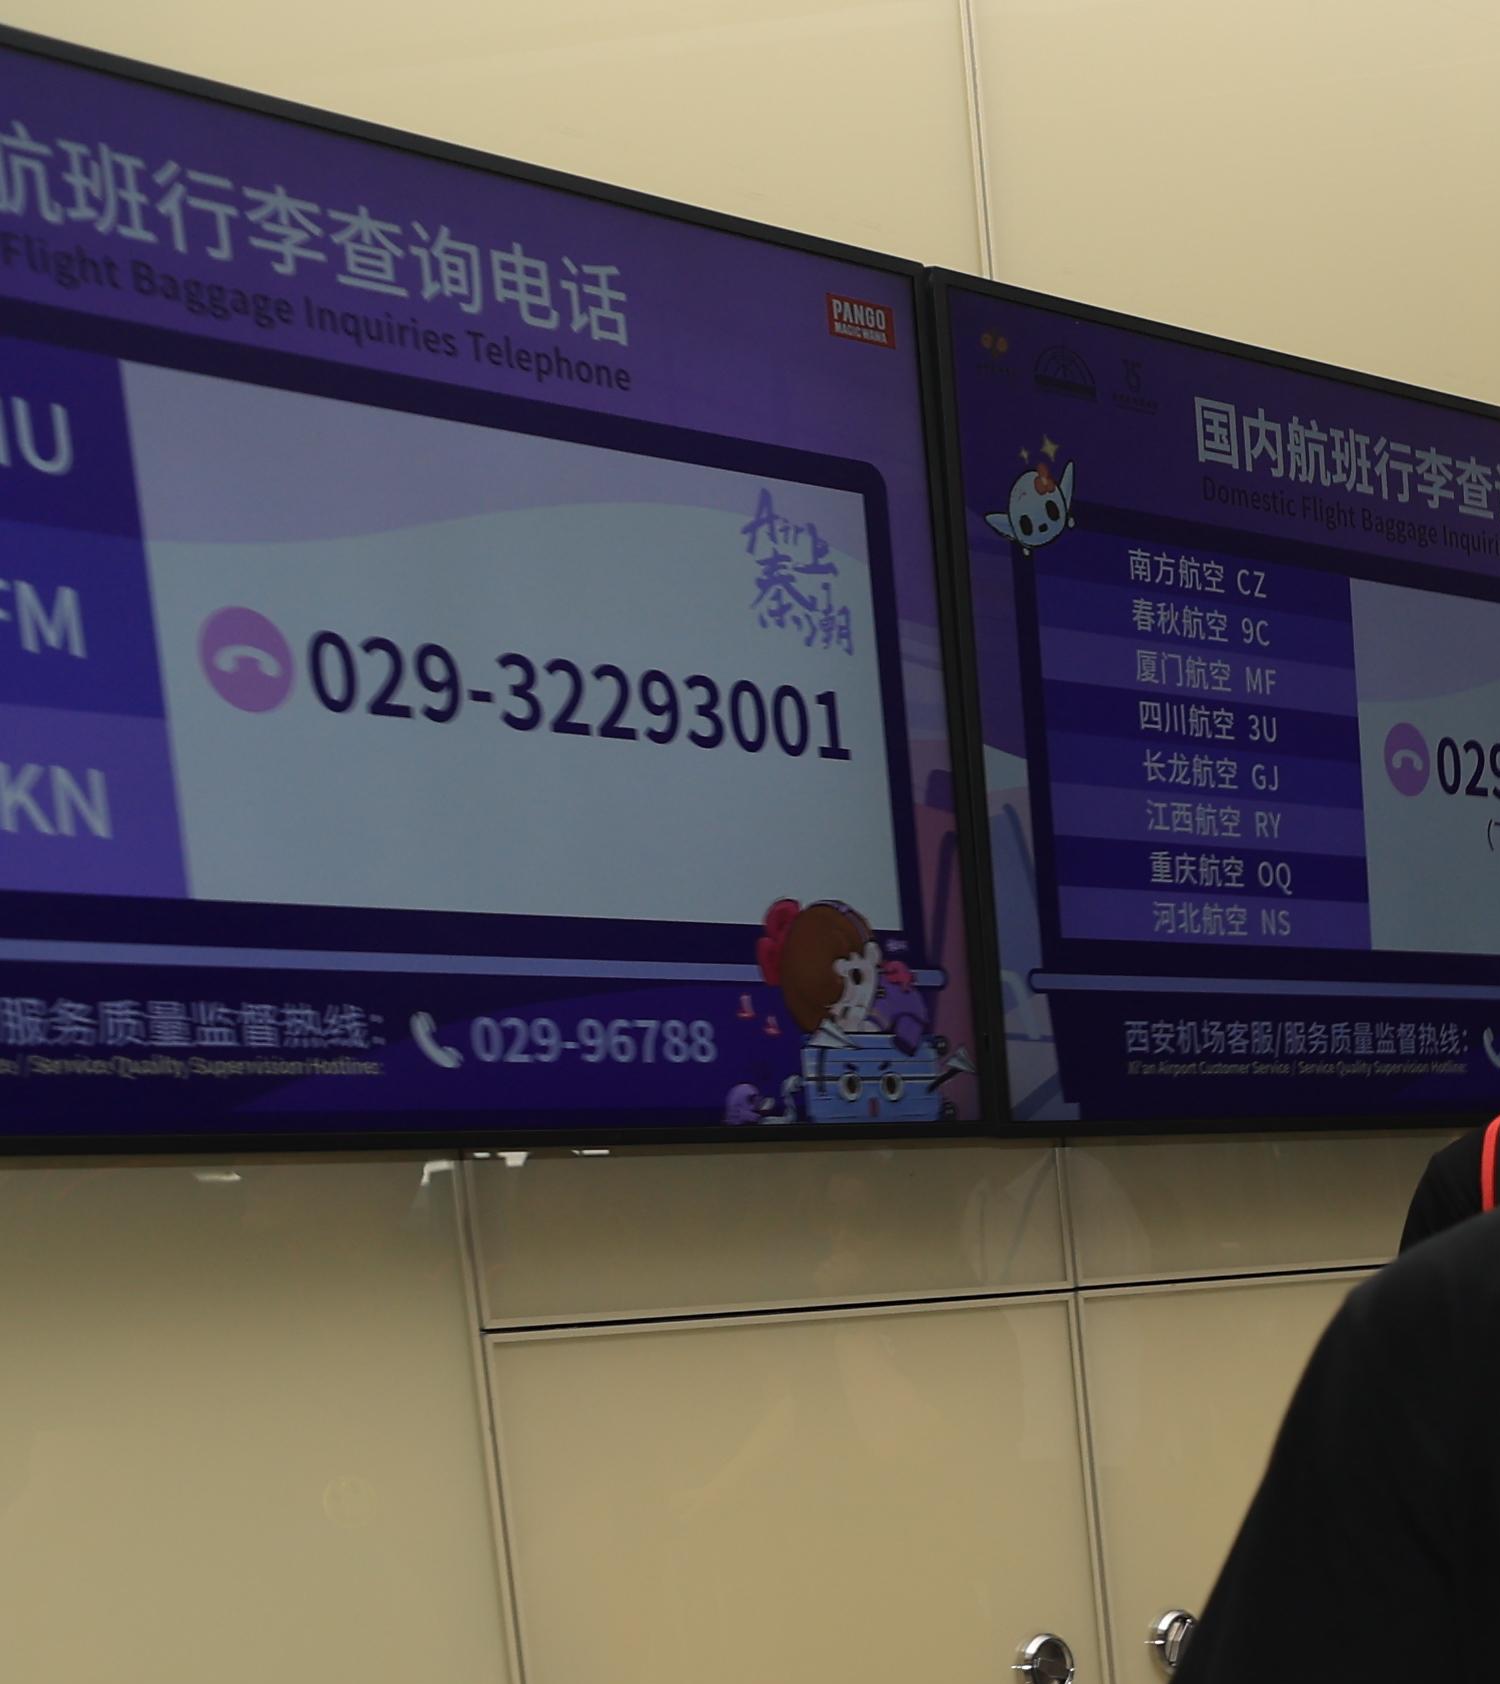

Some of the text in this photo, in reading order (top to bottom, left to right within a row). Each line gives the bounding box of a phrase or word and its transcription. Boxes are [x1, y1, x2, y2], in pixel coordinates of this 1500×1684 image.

[132, 261, 294, 325] Baggage
[305, 297, 458, 358] Inquiries
[466, 330, 631, 392] Telephone
[831, 298, 886, 331] PANGO
[1202, 475, 1296, 518] Domestic
[1302, 499, 1356, 532] Flight
[1361, 508, 1438, 548] Baggage
[1127, 548, 1267, 598] 南方航空 CZ
[1131, 598, 1270, 646] 春秋航空 9C
[1135, 649, 1276, 695] 厦门航空 MF
[308, 630, 851, 761] 029-32293001
[1138, 700, 1276, 743] 四川航空 3U
[1143, 749, 1278, 791] 长龙航空 GJ
[1146, 800, 1280, 838] 江西航空 RY
[1149, 851, 1292, 895] 重庆航空 OQ
[1152, 902, 1291, 937] 河北航空 NS
[470, 1016, 717, 1063] 029-96788
